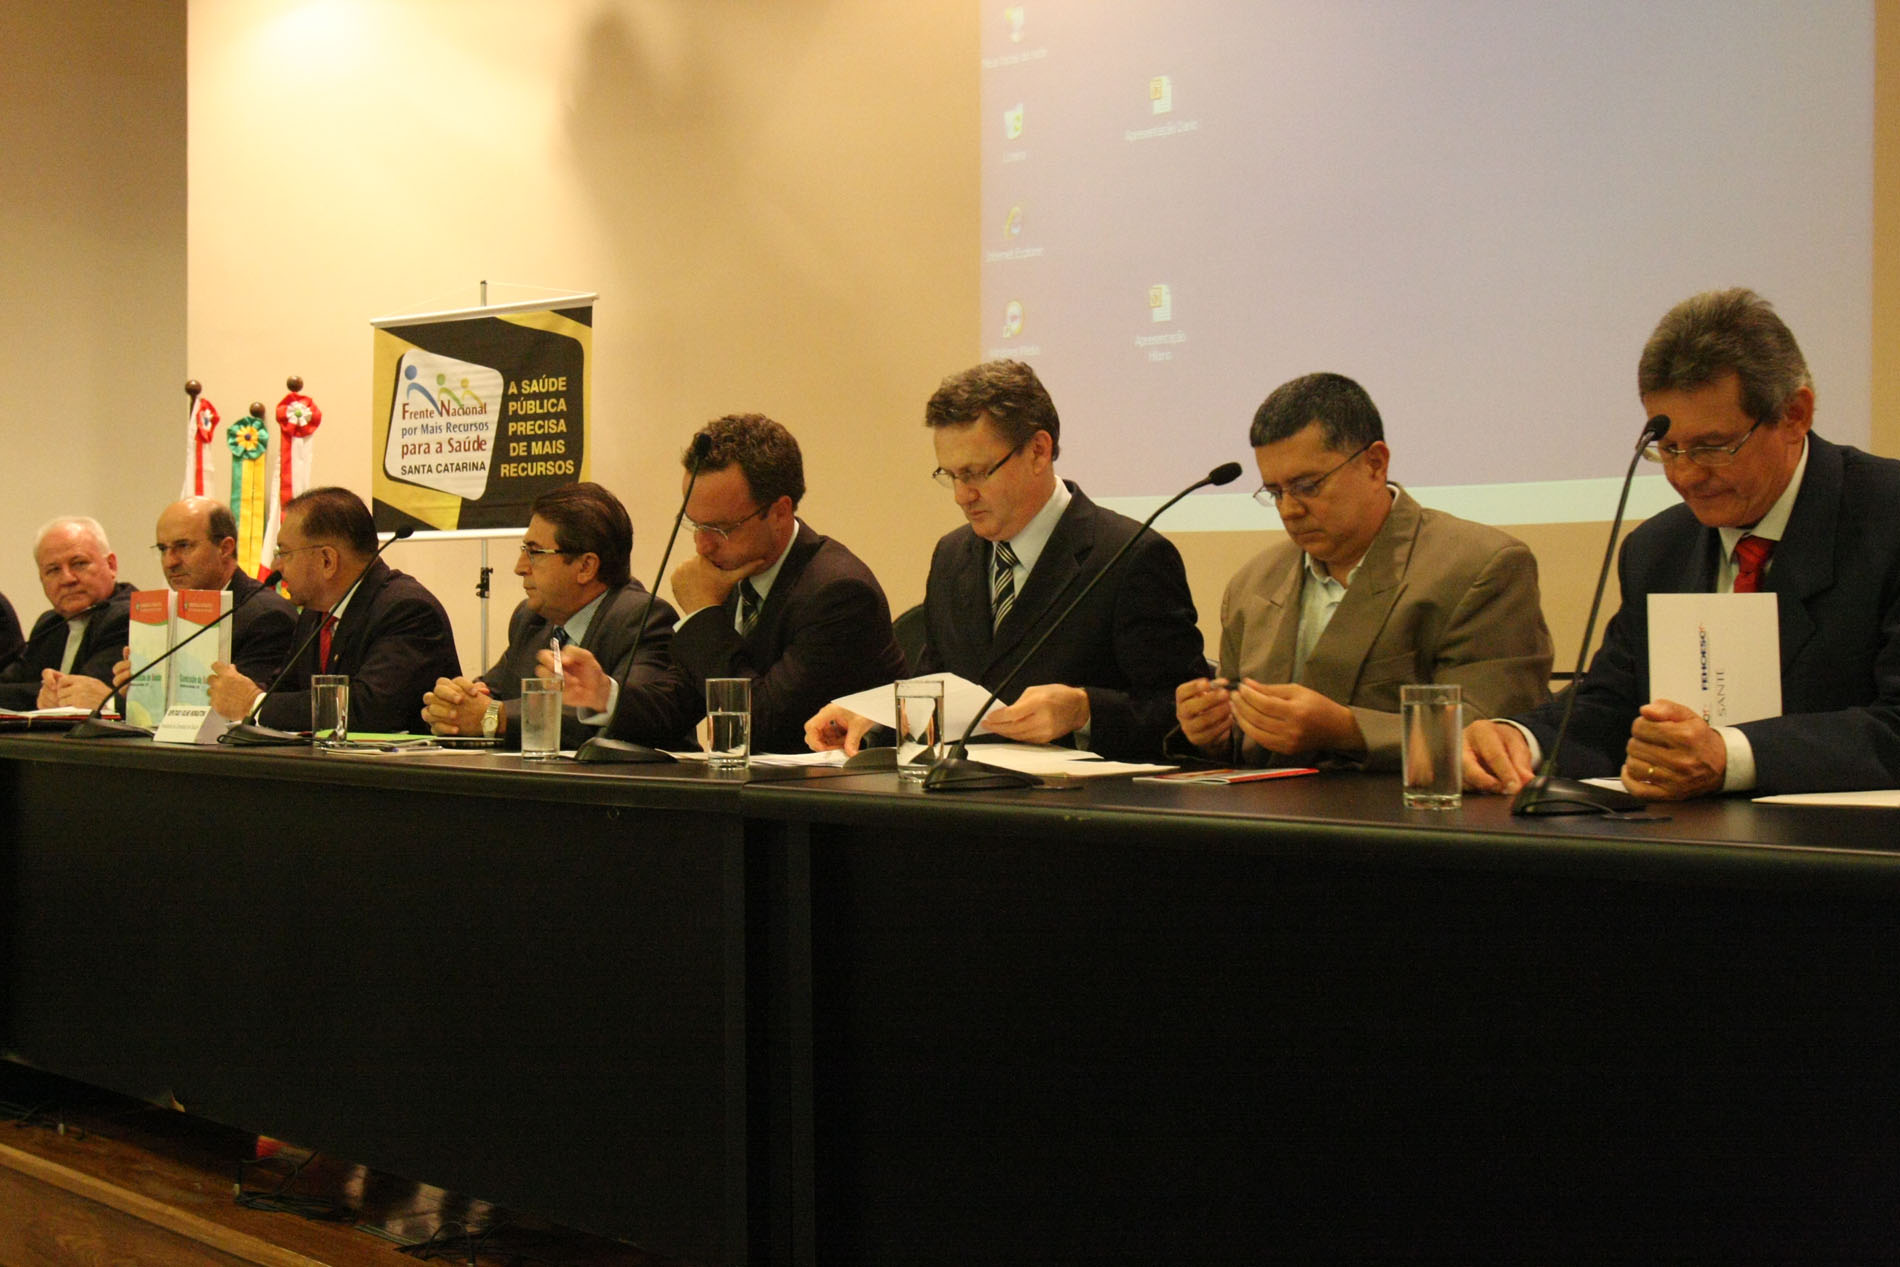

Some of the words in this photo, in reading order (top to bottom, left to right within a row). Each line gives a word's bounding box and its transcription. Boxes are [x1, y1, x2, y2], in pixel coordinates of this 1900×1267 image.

[508, 382, 518, 394] A
[521, 375, 566, 393] SAÚDE
[402, 403, 434, 420] Frente
[440, 400, 487, 417] Nacional
[508, 398, 566, 416] PÚBLICA
[402, 425, 417, 439] por
[421, 423, 442, 435] Mais
[447, 421, 489, 433] Recursos
[508, 419, 566, 436] PRECISA
[402, 439, 430, 459] para
[436, 440, 442, 453] a
[448, 435, 487, 453] Saúde
[510, 442, 527, 456] DE
[531, 440, 565, 455] MAIS
[401, 463, 433, 475] SANTA
[436, 461, 486, 474] CATARINA
[500, 460, 574, 477] RECURSOS
